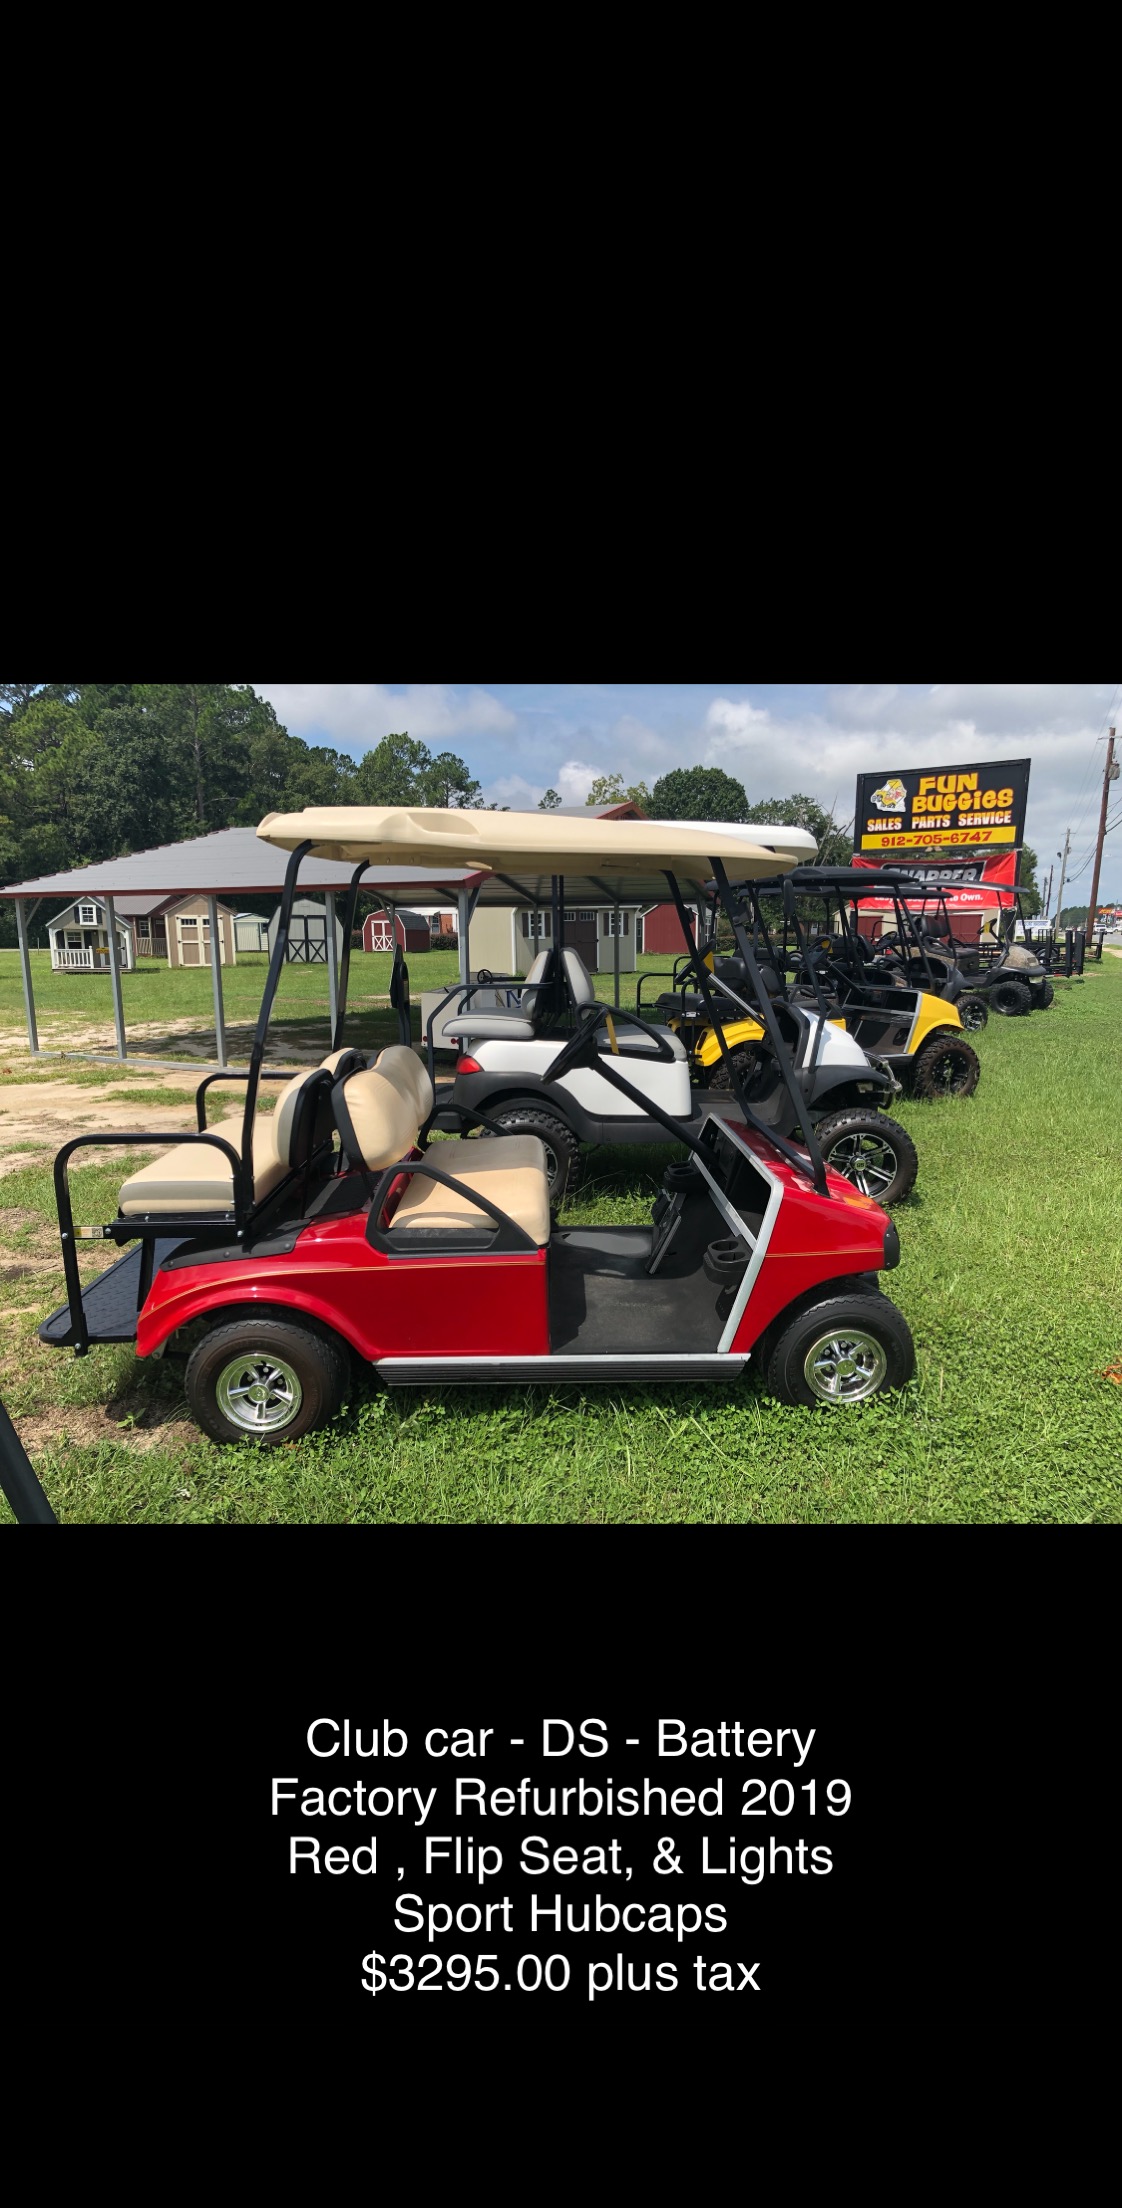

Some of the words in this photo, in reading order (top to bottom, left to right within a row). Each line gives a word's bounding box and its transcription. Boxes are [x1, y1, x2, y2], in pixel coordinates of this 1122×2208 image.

[919, 772, 979, 796] FUN
[867, 817, 902, 832] SALES
[911, 814, 951, 829] PARTS
[958, 810, 1012, 827] SERVICE
[881, 831, 993, 847] 912-705-6747
